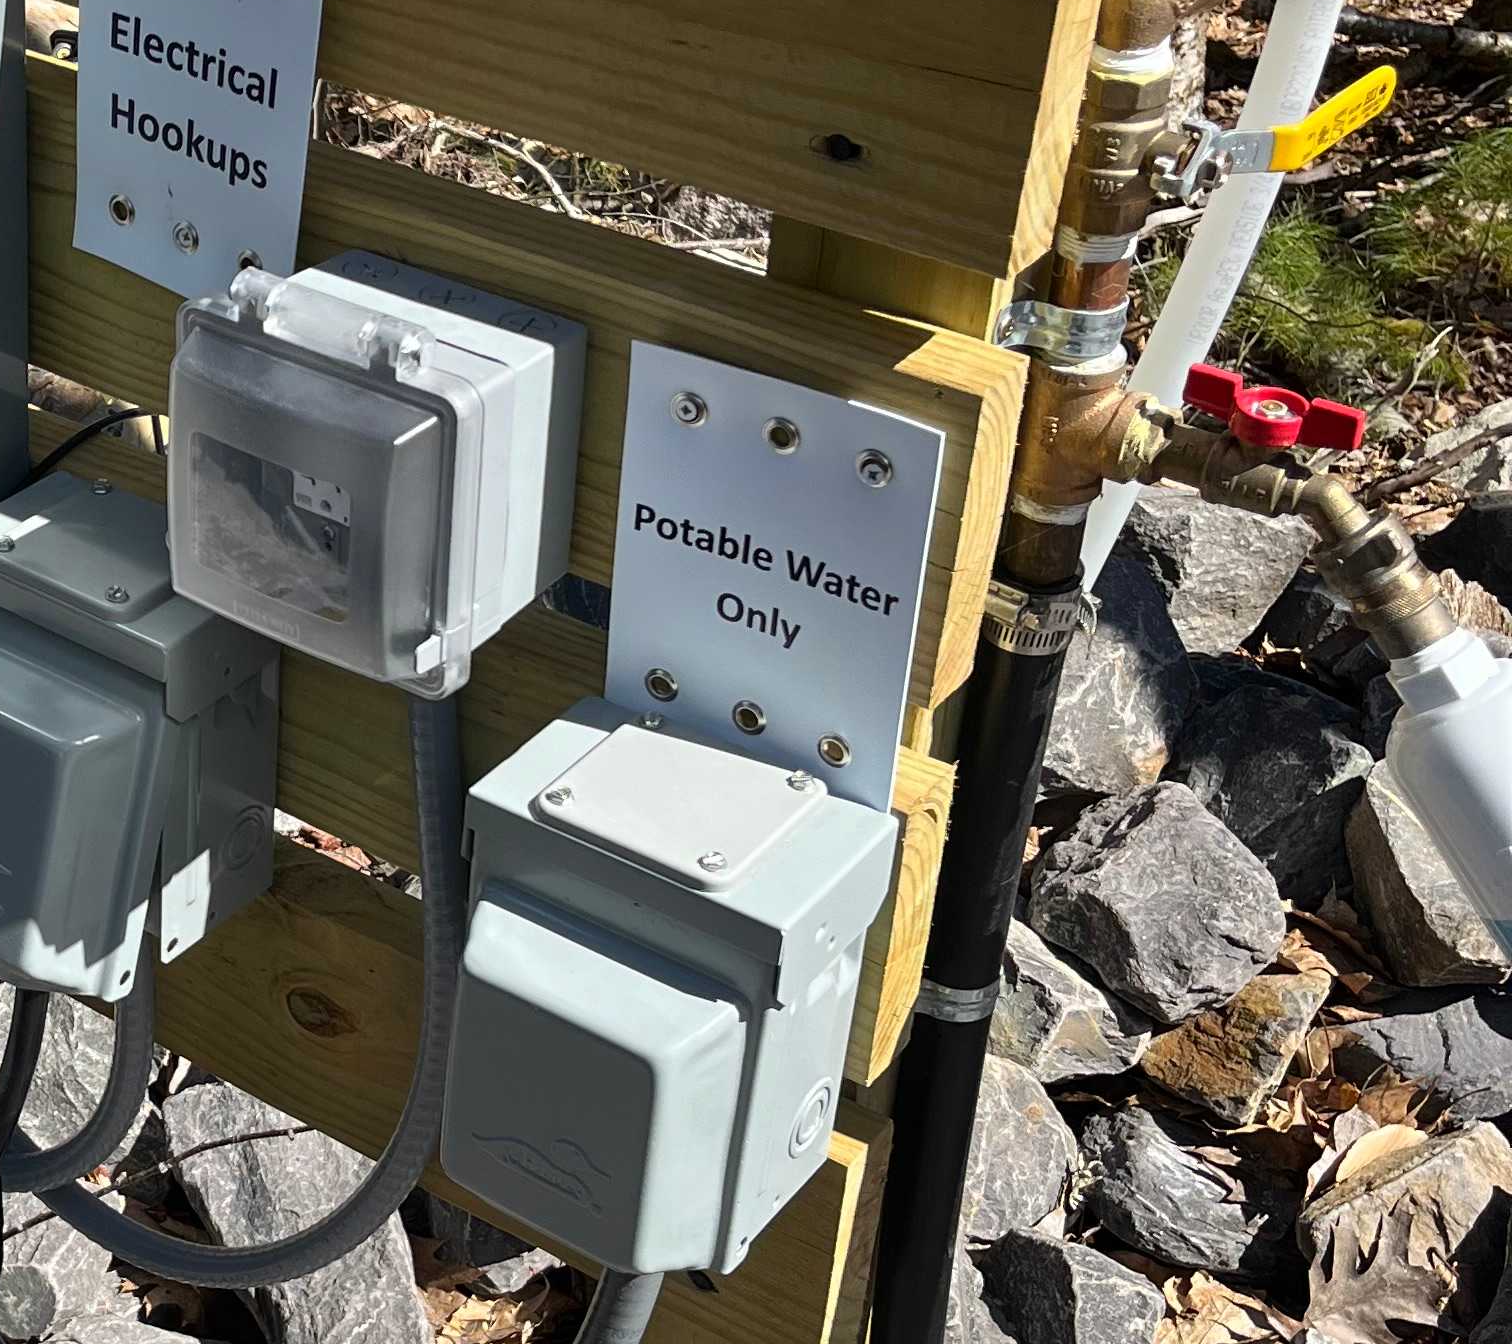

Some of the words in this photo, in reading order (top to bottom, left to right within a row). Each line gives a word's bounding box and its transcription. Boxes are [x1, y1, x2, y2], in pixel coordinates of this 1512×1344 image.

[110, 11, 278, 109] Electrical
[110, 92, 268, 189] Hookups
[633, 503, 773, 571] Potable
[786, 549, 900, 616] Water
[716, 592, 801, 649] Only
